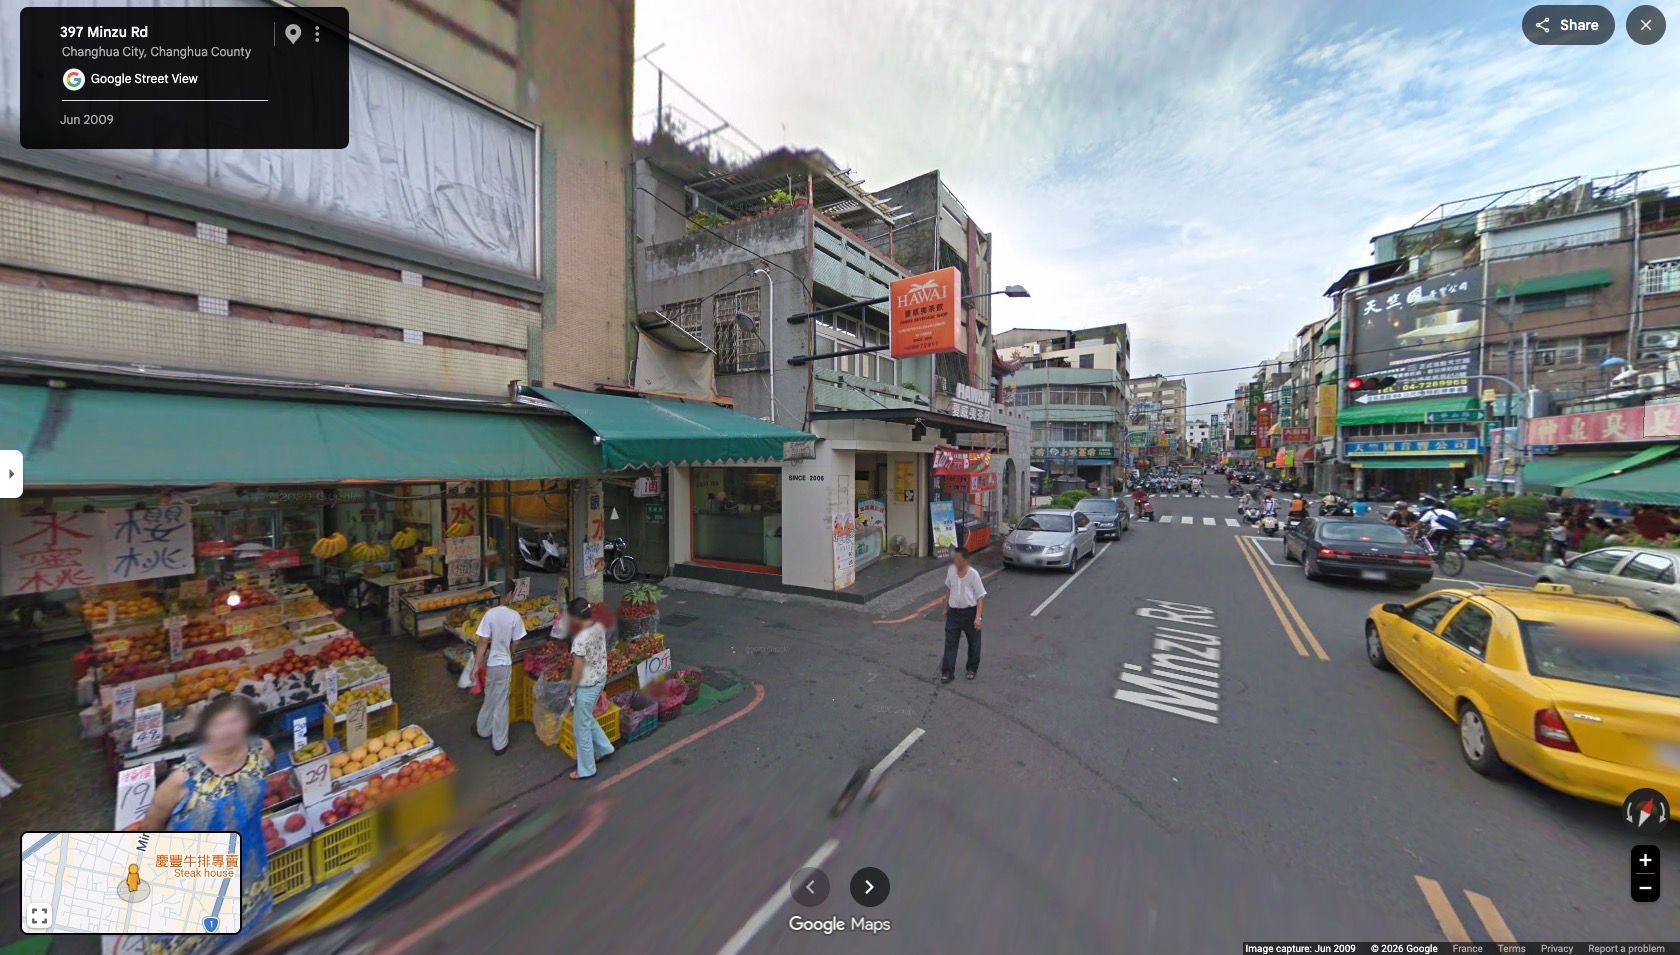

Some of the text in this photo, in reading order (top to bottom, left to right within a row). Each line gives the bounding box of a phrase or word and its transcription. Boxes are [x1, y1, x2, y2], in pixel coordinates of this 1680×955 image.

[897, 285, 948, 309] HAWAI
[113, 506, 188, 577] 櫻桃
[306, 764, 328, 785] 29
[121, 782, 151, 810] 19
